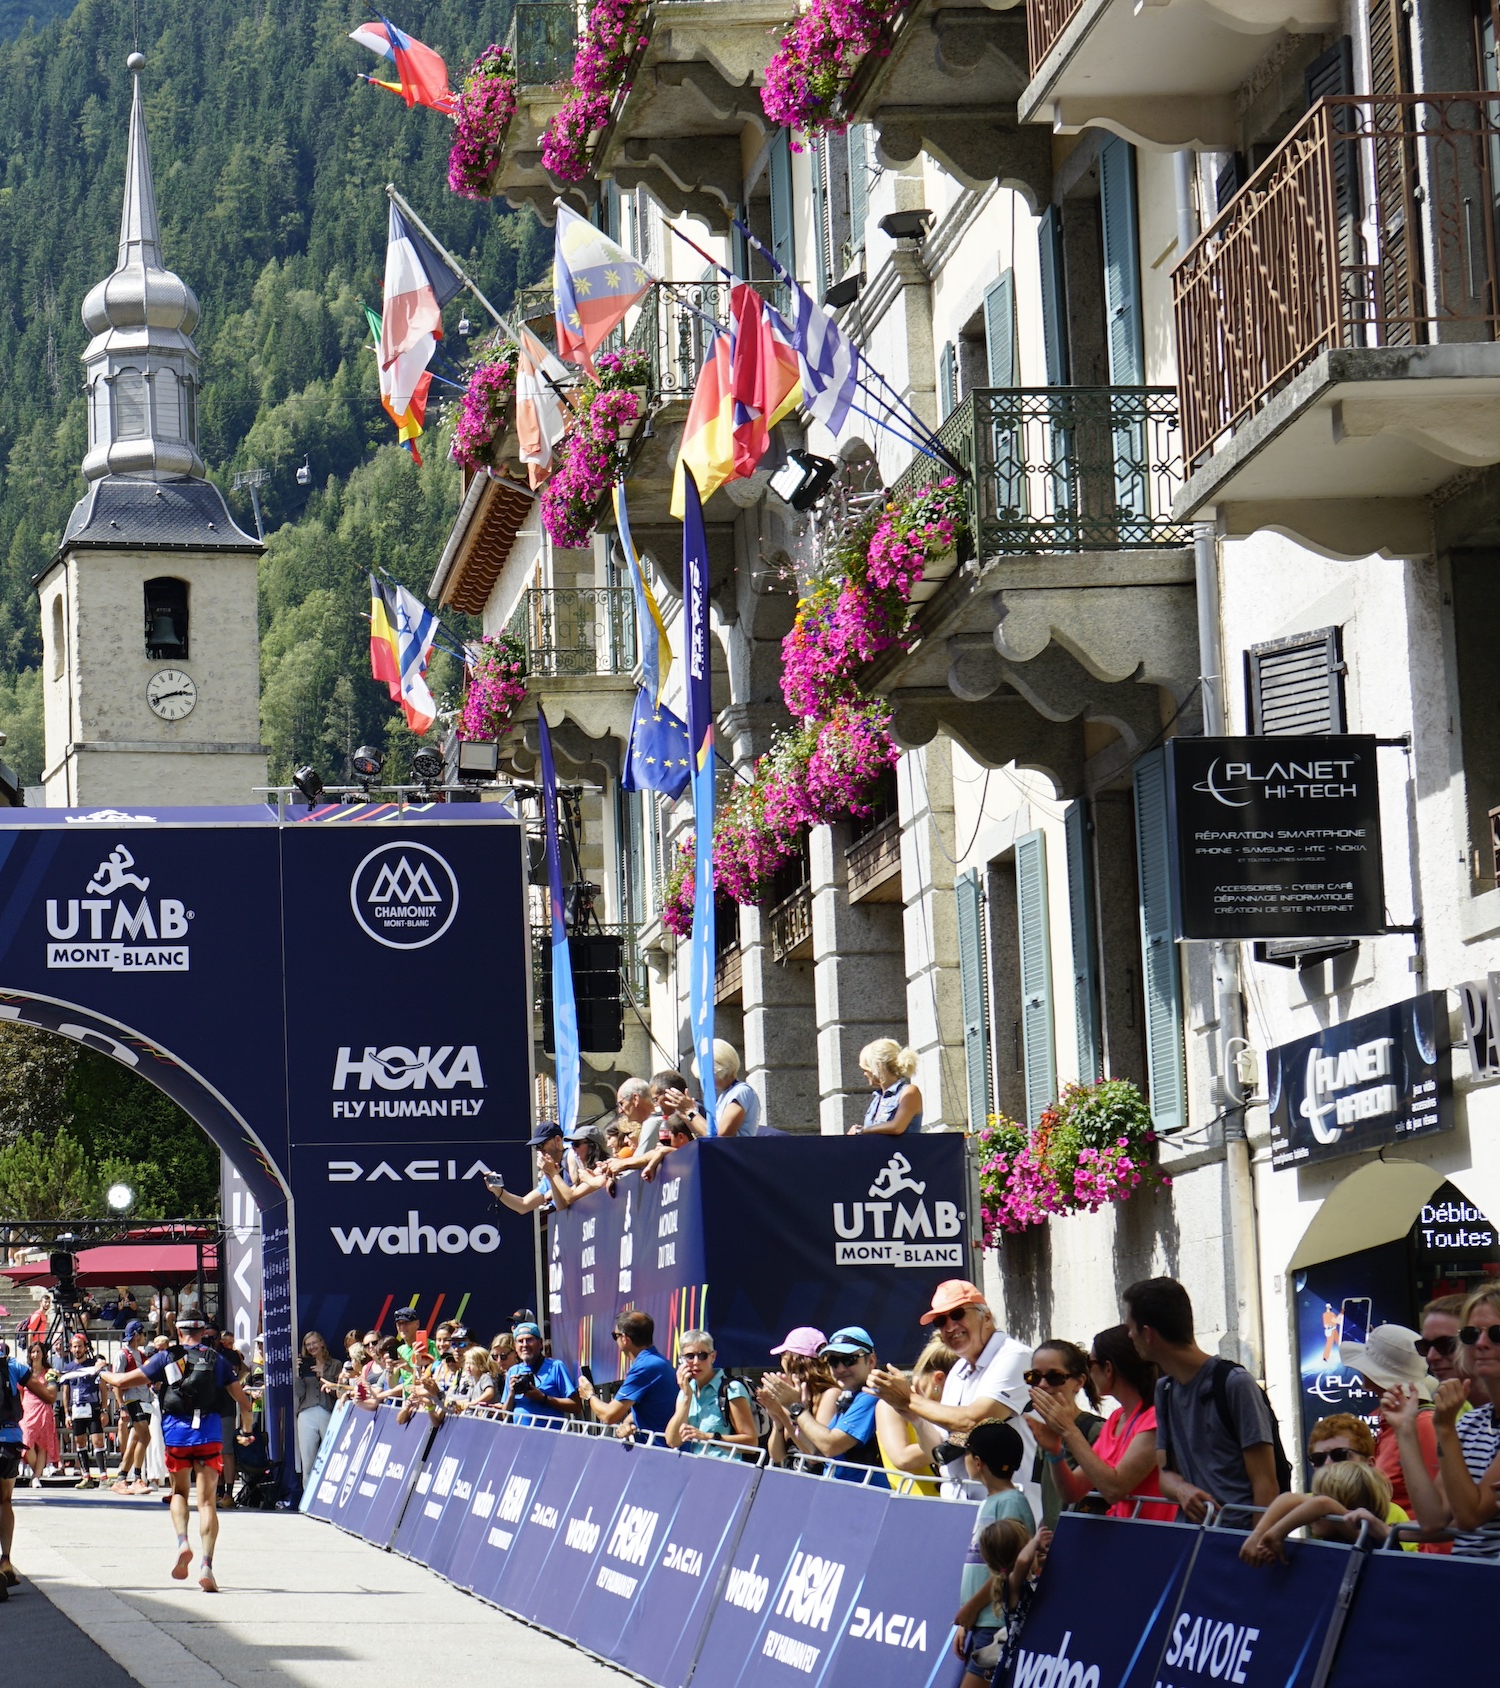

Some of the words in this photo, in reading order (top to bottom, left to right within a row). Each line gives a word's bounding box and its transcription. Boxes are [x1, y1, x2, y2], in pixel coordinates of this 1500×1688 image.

[1226, 760, 1354, 781] PLANET
[1264, 784, 1357, 798] HI-TECH
[1195, 829, 1274, 840] RÉPARATION
[1277, 828, 1367, 839] SMARTPHONE
[1242, 845, 1295, 854] SAMSUNG
[1304, 845, 1325, 853] HTC
[1336, 844, 1367, 852] NOKIA
[1214, 883, 1282, 892] ACCESSOIRES
[1291, 882, 1325, 891] CYBER
[1214, 893, 1278, 903] DÉPANNAGE
[1280, 892, 1354, 902] INFORMATIQUE
[46, 896, 189, 941] UTMB
[374, 905, 437, 919] CHAMONIX
[383, 919, 430, 928] MONT-BLANC
[1214, 904, 1263, 914] CRÉATION
[1265, 905, 1280, 913] DE
[1281, 905, 1304, 913] SITE
[1306, 904, 1354, 912] INTERNET
[332, 1045, 486, 1091] HOKA
[1315, 1037, 1395, 1094] PLANET
[332, 1100, 366, 1118] FLY
[369, 1100, 448, 1118] HUMAN
[451, 1099, 485, 1117] FLY
[1336, 1084, 1398, 1125] HI-TECH
[328, 1160, 493, 1181] DACIA
[330, 1210, 500, 1255] wahoo
[833, 1199, 962, 1239] UTMB
[1422, 1229, 1492, 1248] Toutes
[565, 1507, 601, 1554] wahoo
[607, 1504, 660, 1566] HOKA
[663, 1542, 703, 1577] DACIA
[724, 1554, 769, 1613] wahoo
[776, 1551, 846, 1632] HOKA
[849, 1606, 927, 1652] DACIA
[1013, 1631, 1100, 1688] wahoo
[1165, 1613, 1260, 1684] SAVOIE
